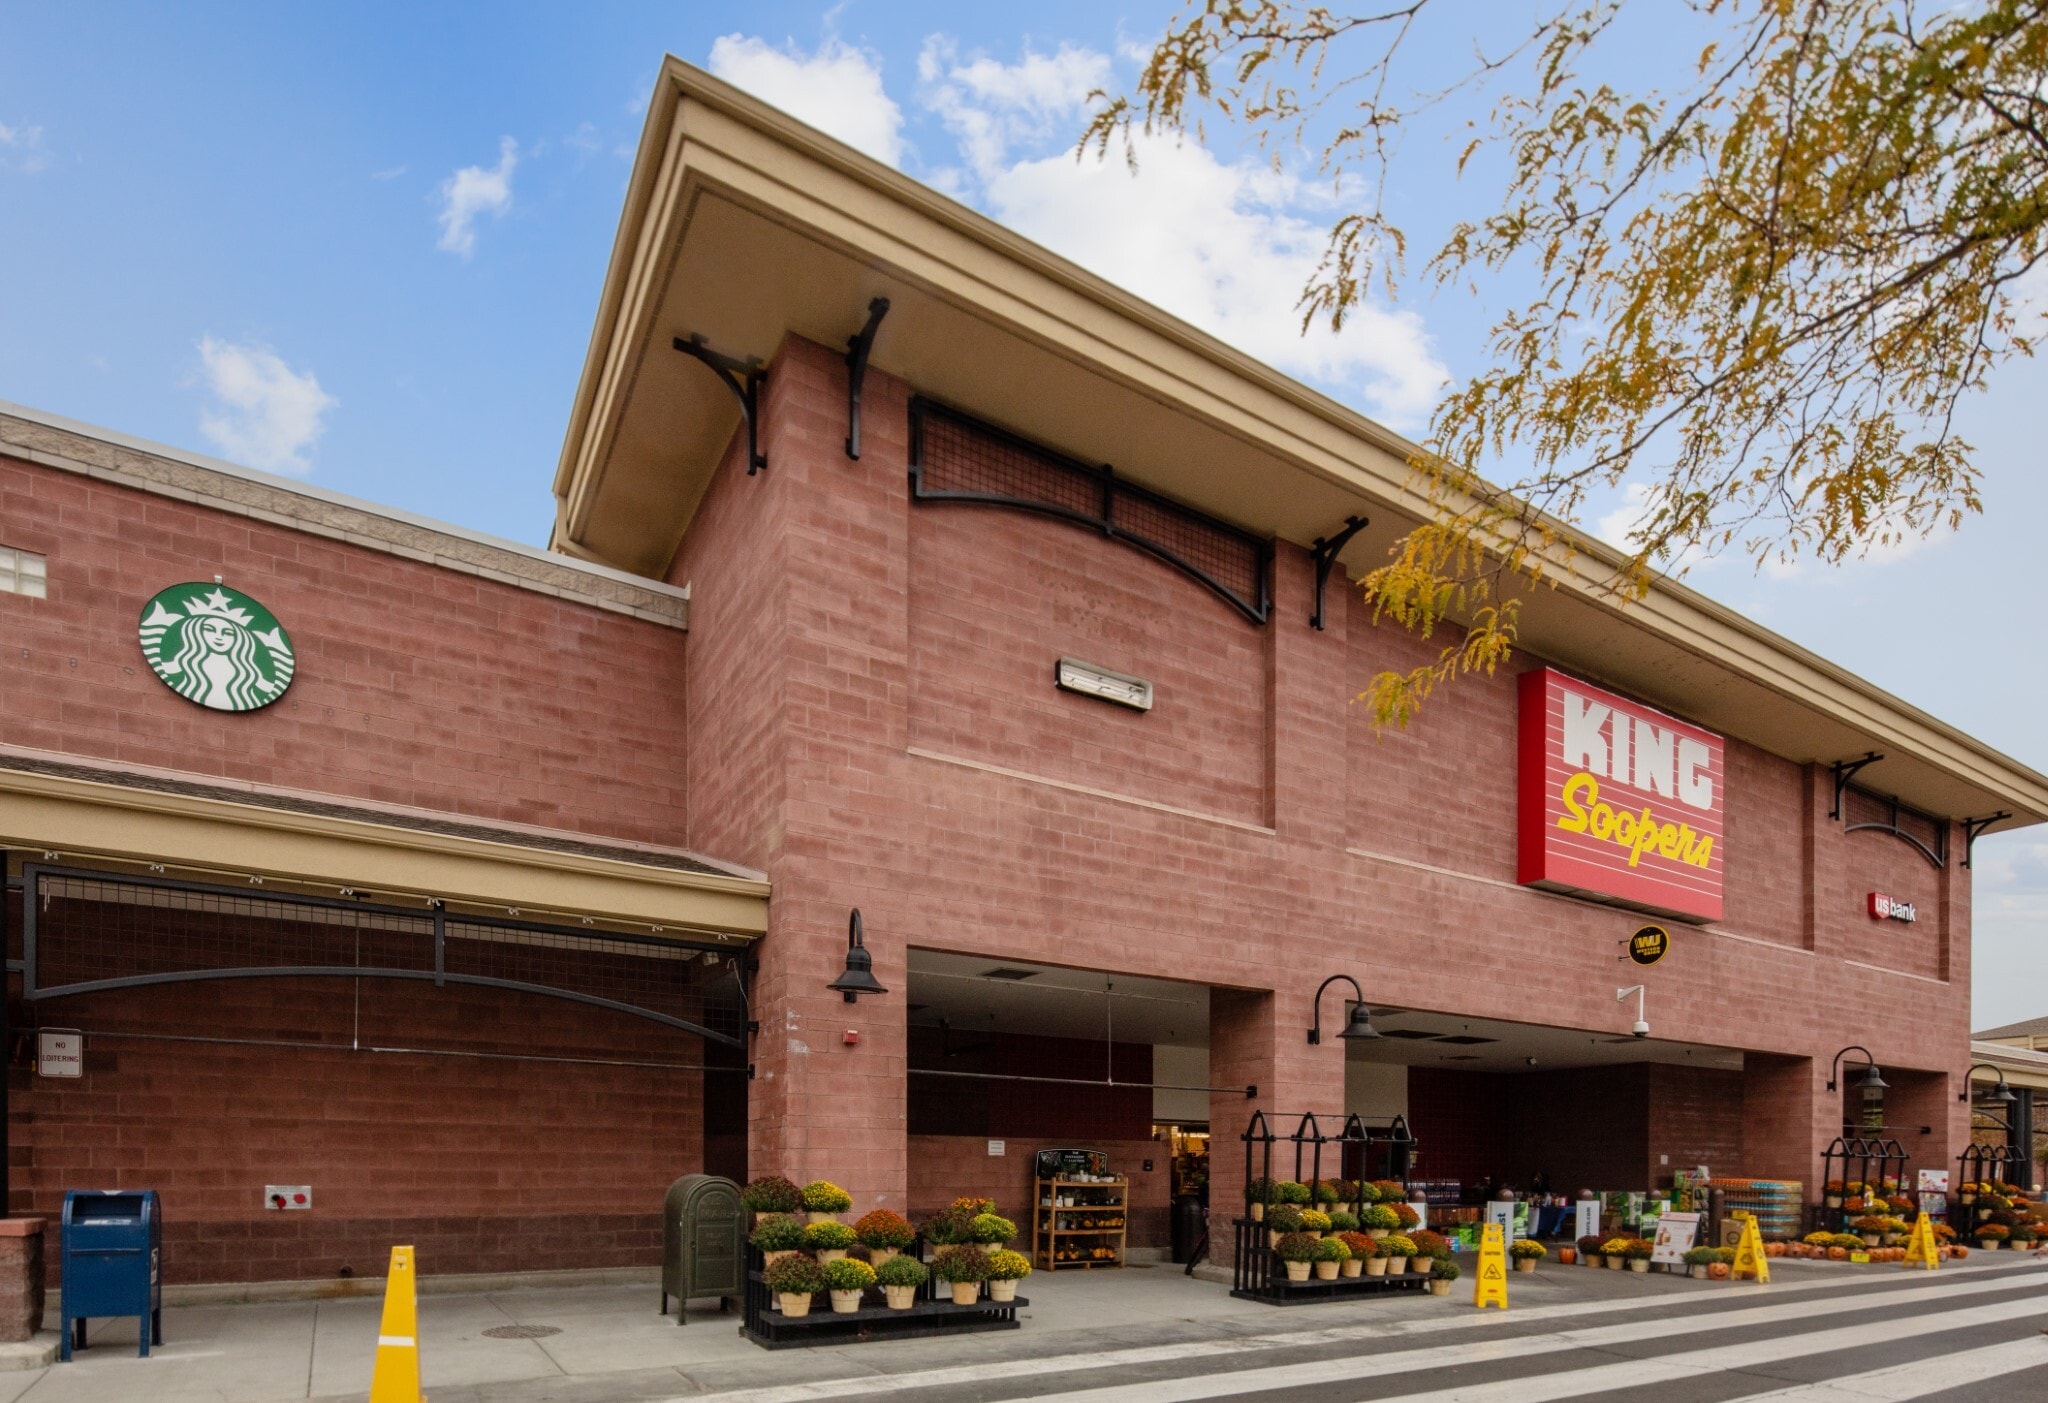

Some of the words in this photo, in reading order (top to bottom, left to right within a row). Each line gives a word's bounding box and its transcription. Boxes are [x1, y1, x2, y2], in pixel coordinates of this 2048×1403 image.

[1563, 690, 1712, 810] KING
[1557, 772, 1714, 868] Soopers
[1634, 934, 1661, 949] WU
[55, 1041, 66, 1049] NO
[42, 1054, 79, 1063] LOITERING
